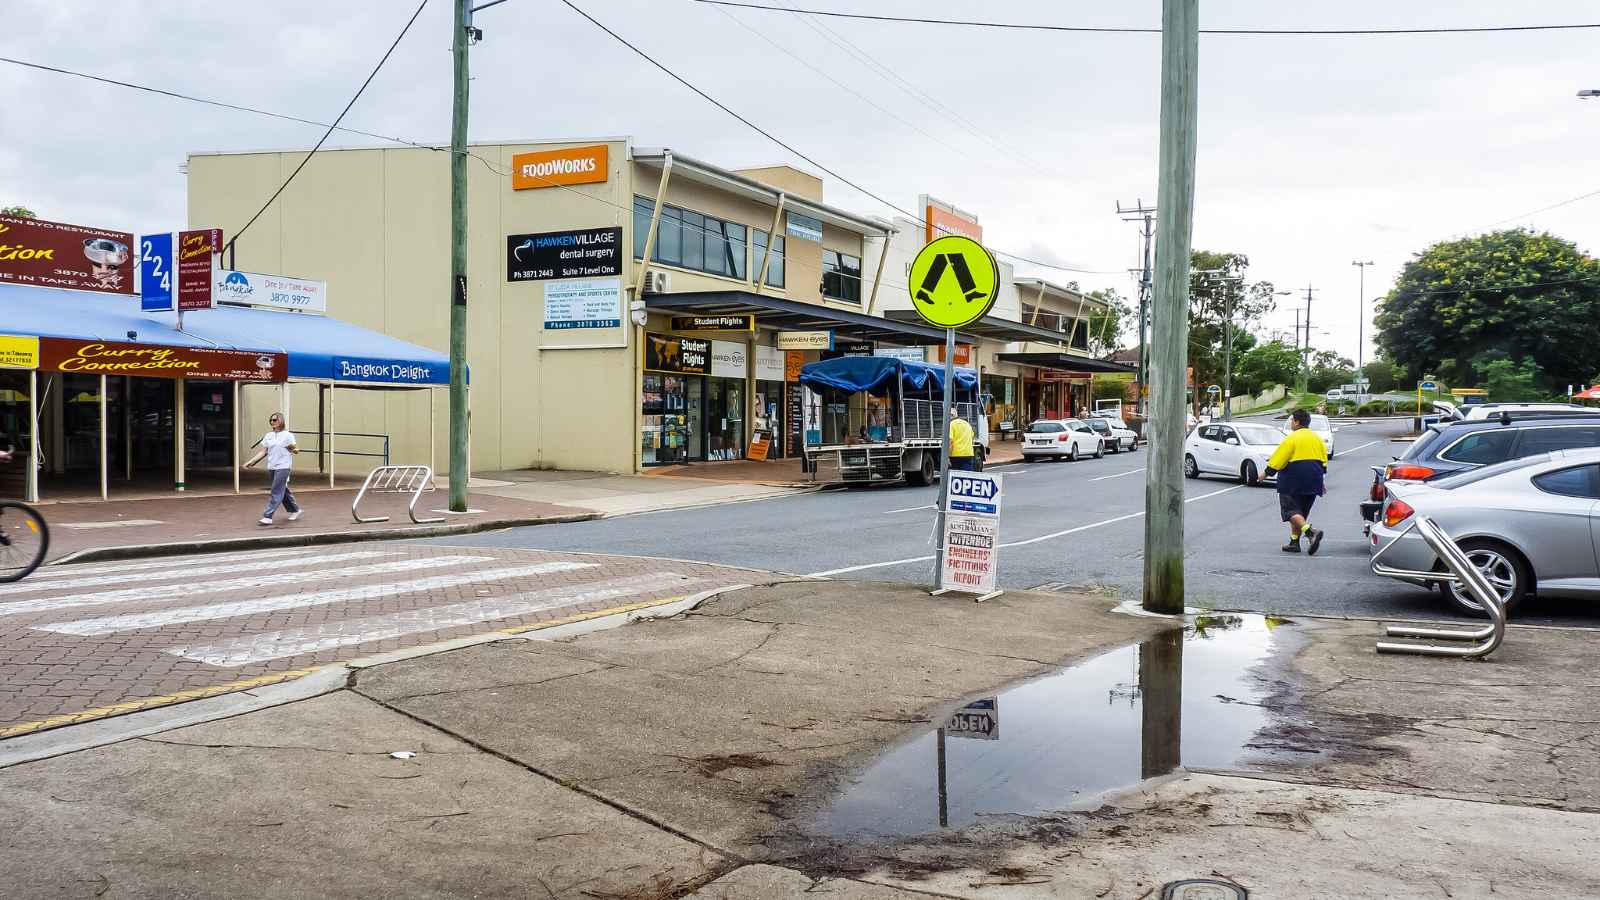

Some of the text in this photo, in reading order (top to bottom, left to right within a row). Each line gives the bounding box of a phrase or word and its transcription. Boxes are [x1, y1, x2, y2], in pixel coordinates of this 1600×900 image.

[522, 158, 596, 178] FOODWORKS
[26, 220, 54, 229] BYO
[56, 225, 126, 239] RESTAURANT
[560, 247, 614, 259] dental surgery
[54, 268, 88, 278] 3870
[513, 265, 615, 279] Ph 3871 2443 Suite 7 Level One
[18, 274, 35, 282] IN
[40, 276, 79, 287] TAKE
[80, 281, 124, 291] AWAY
[694, 316, 743, 328] Student Flights
[77, 343, 176, 361] Curry
[681, 339, 707, 352] Student
[58, 357, 201, 371] Connection
[682, 352, 705, 366] Flights
[340, 360, 430, 380] Bangkok Delight
[951, 478, 992, 497] OPEN
